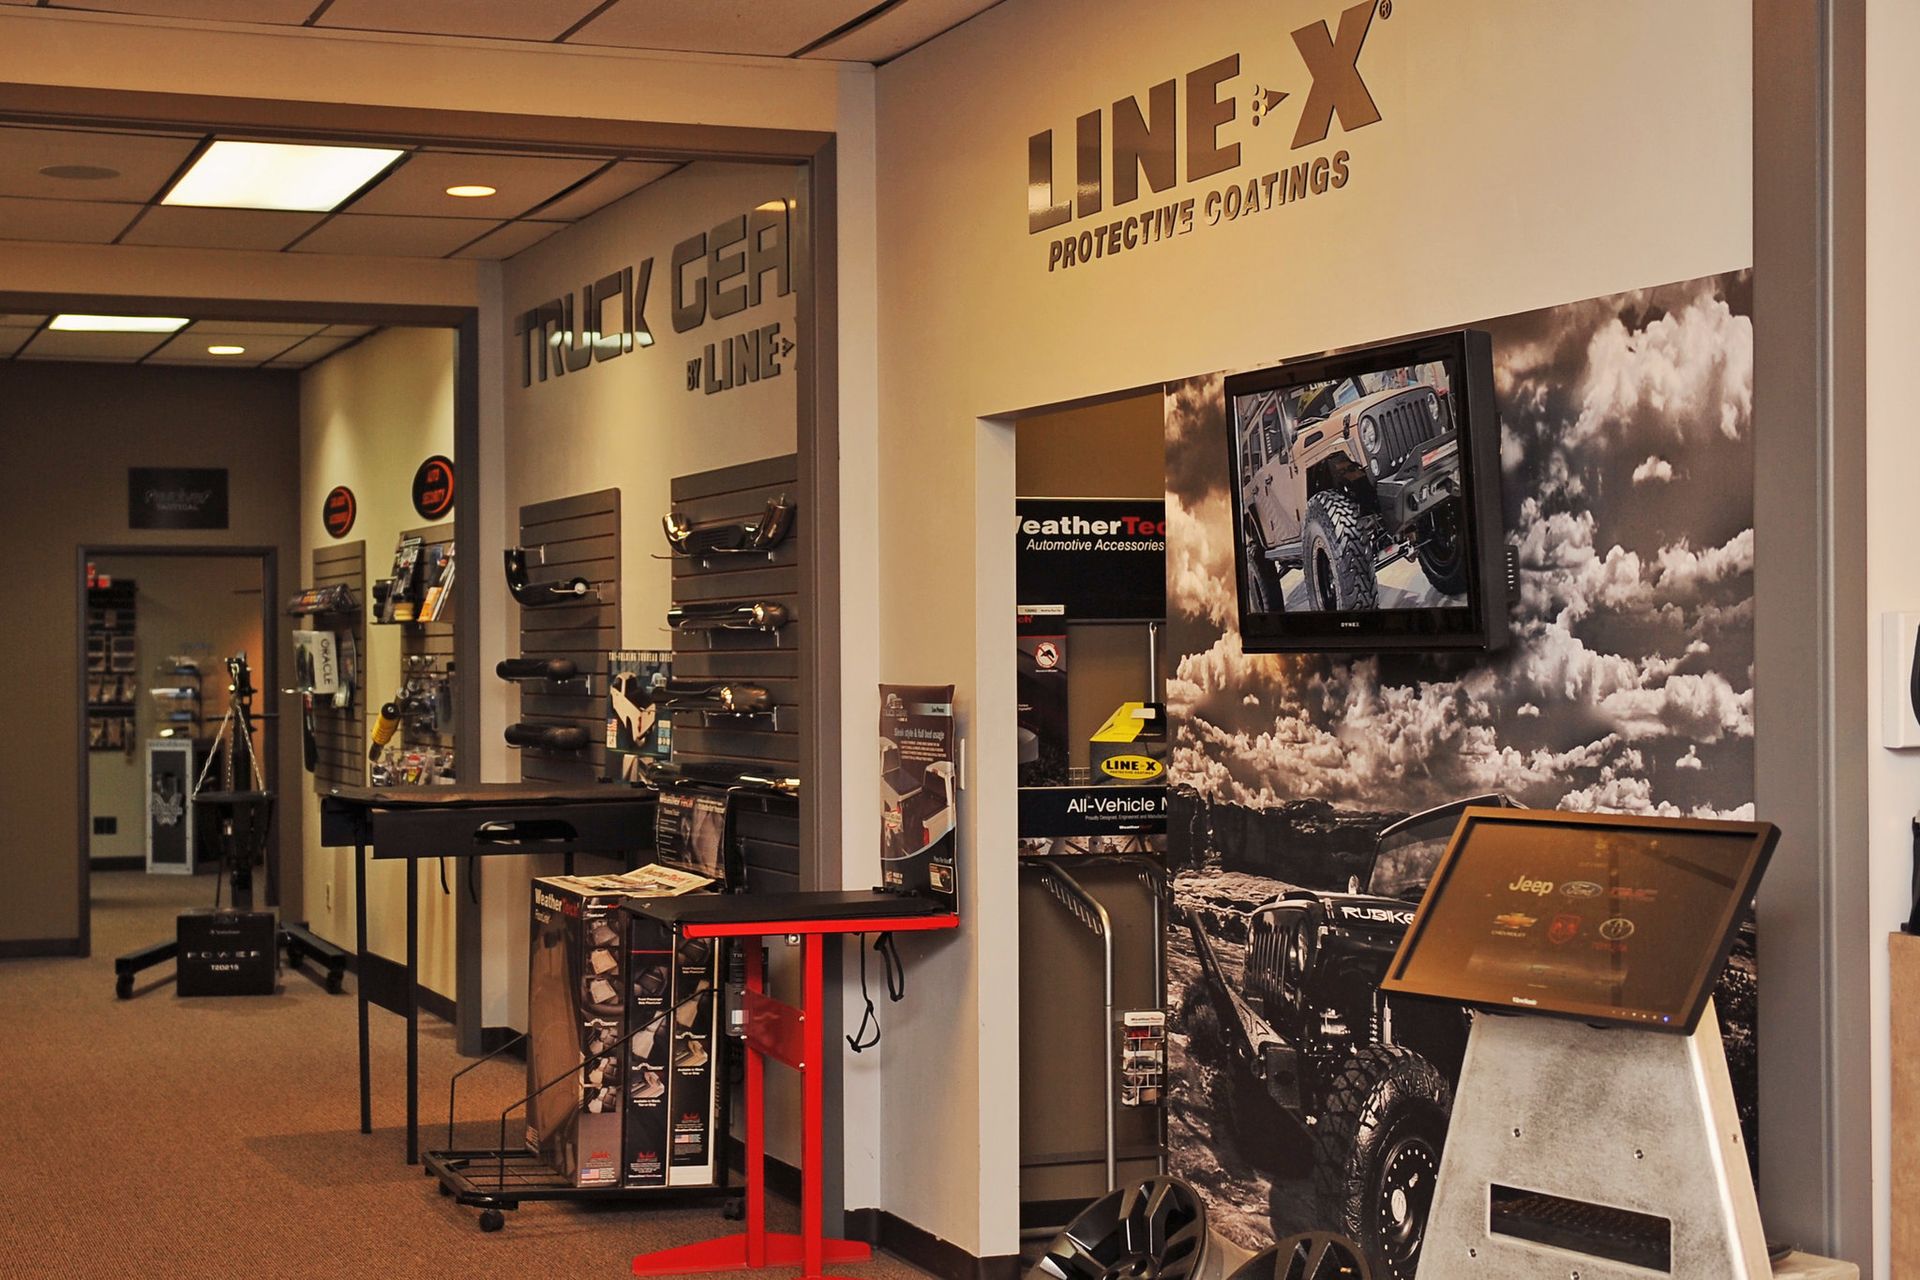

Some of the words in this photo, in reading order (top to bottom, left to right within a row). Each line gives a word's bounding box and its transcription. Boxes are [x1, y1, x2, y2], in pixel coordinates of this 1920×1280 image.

[1048, 197, 1195, 272] PROTECTIVE
[1204, 150, 1350, 226] COATINGS
[514, 257, 655, 388] TRUCK
[671, 198, 797, 334] GEA
[687, 358, 702, 391] BY
[1026, 538, 1092, 551] Automotive
[1094, 538, 1165, 551] Accessories
[320, 638, 332, 685] ORACLE
[1067, 797, 1156, 813] All-Vehicle
[1509, 875, 1554, 897] Jeep
[1566, 883, 1595, 896] Ford
